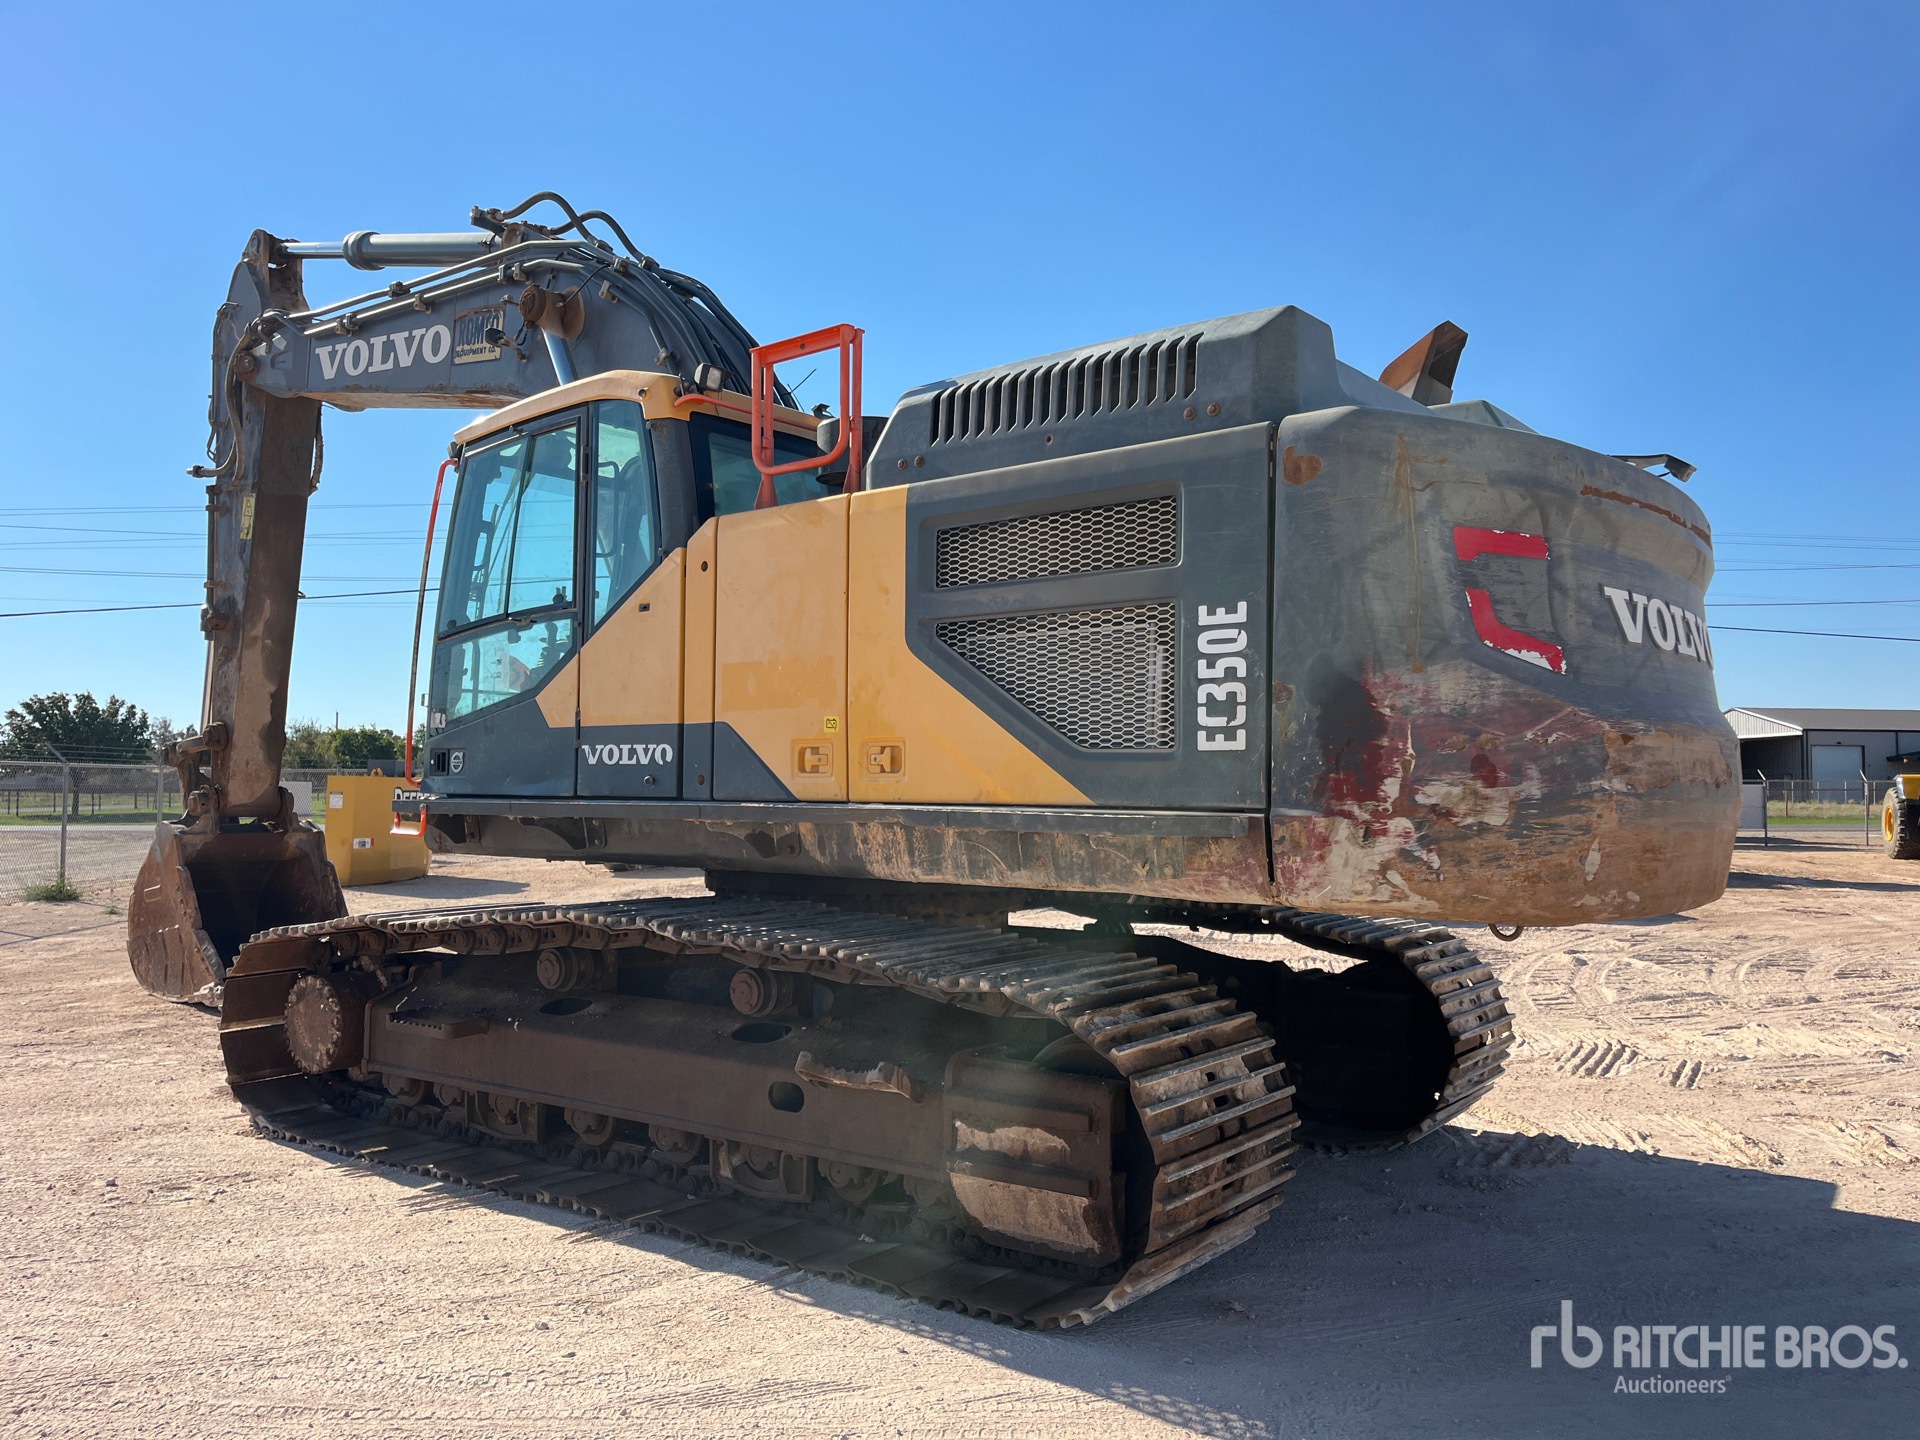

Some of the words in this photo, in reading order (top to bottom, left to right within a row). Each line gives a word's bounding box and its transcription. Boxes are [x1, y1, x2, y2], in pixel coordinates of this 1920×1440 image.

[315, 324, 451, 380] VOLVO
[456, 346, 487, 357] EQUIPMENT
[1197, 601, 1248, 751] EC350E
[581, 743, 674, 766] VOLVO
